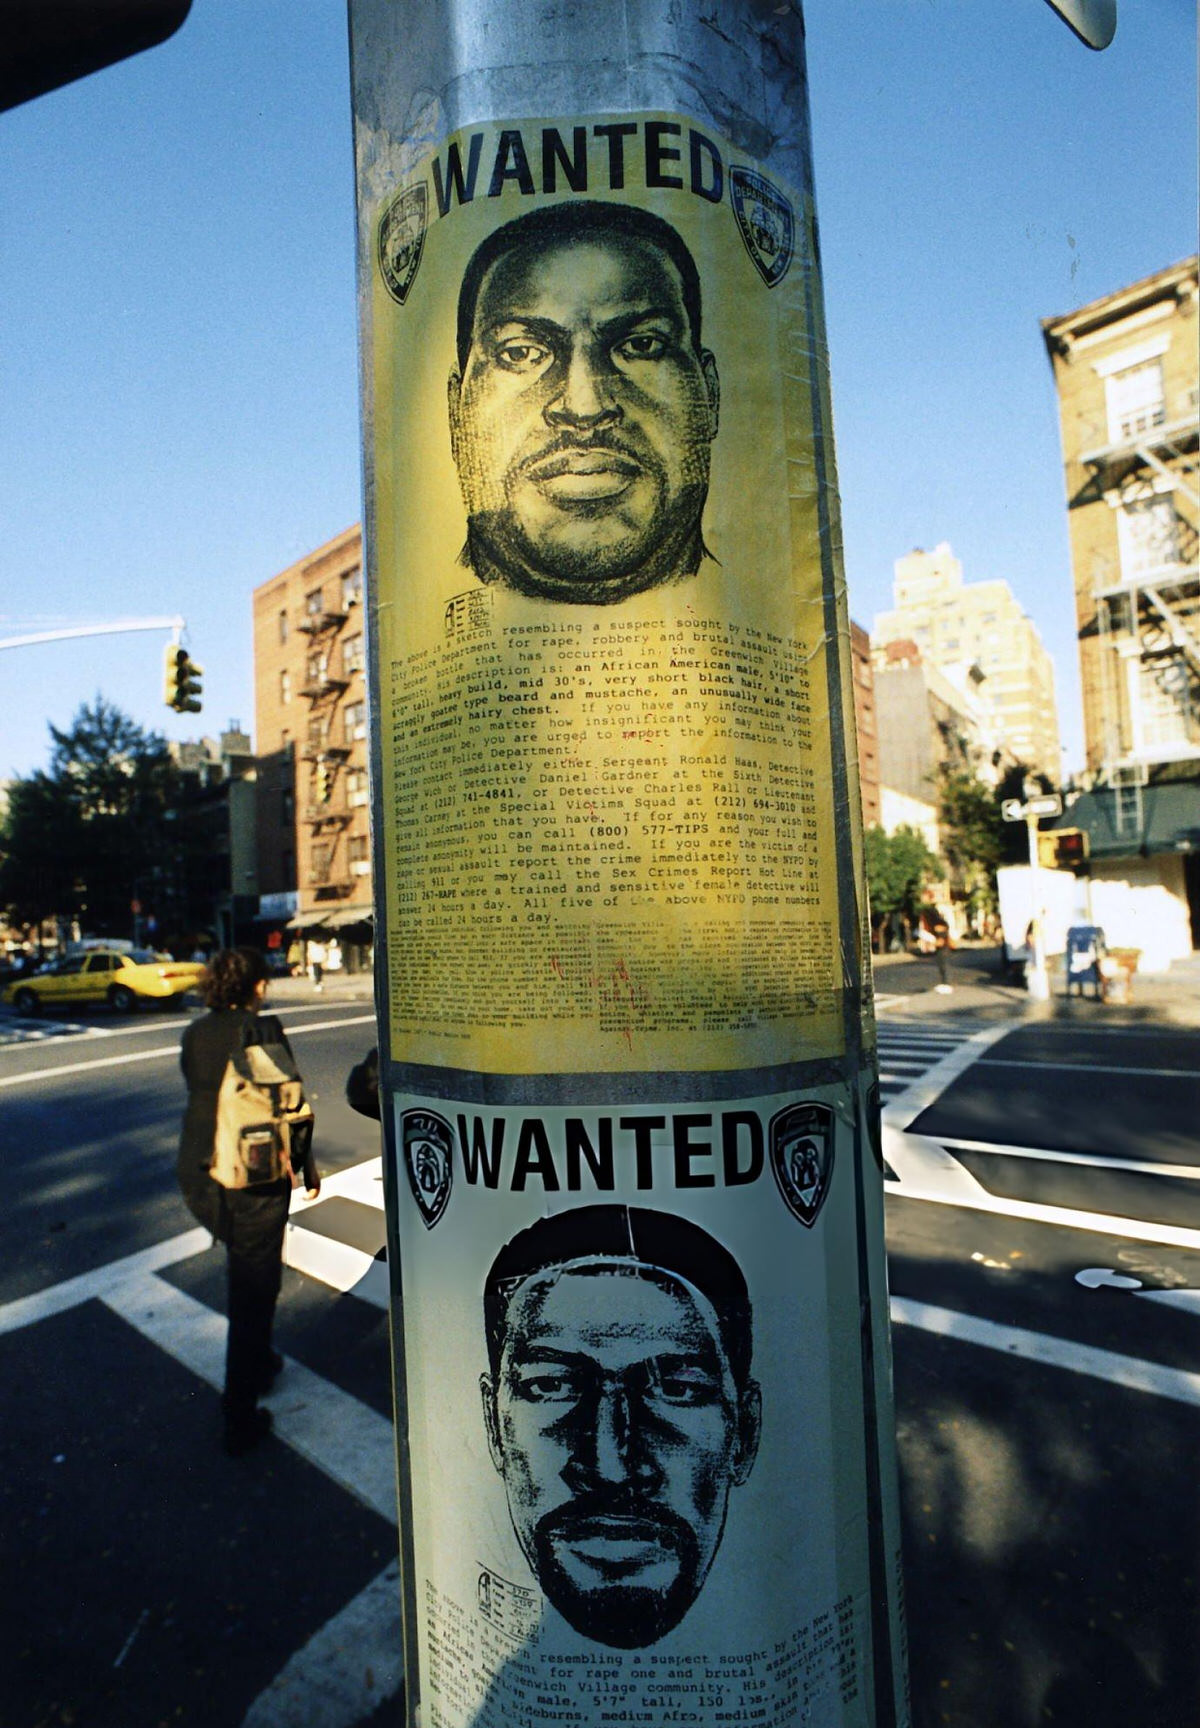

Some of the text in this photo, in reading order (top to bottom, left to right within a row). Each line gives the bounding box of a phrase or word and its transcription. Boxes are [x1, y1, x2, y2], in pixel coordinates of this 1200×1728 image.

[431, 121, 724, 219] WANTED
[508, 632, 734, 649] for robbery and brutal
[475, 646, 764, 667] that has occurred Greenwich
[455, 658, 731, 685] description is: an African American
[518, 672, 735, 690] mid very short black
[463, 686, 812, 714] type beard and an unusually wide face
[468, 701, 781, 721] hairy chest. If you have any information
[468, 714, 752, 735] no matter how insignificant you may
[483, 728, 778, 749] you are urged to the information
[451, 745, 579, 766] Police Department.
[543, 753, 727, 771] either Sergeant Ronald
[463, 768, 763, 790] Detective Daniel Gardner at the Sixth
[531, 782, 704, 799] or Detective Charles
[471, 795, 748, 817] the Special Victims Squad at (212)
[492, 810, 756, 829] that you for any reason
[477, 824, 740, 845] you can call (800) 577-TIPS and
[516, 838, 732, 853] be maintained. If you are
[458, 852, 757, 871] assault report the crime immediately to
[530, 866, 751, 881] call the Sex Crimes Report
[494, 879, 740, 896] a trained and sensitive female
[523, 896, 548, 908] All
[560, 896, 594, 908] five
[603, 897, 619, 908] of
[665, 894, 708, 905] above
[717, 893, 746, 904] NYPD
[510, 912, 559, 924] a day.
[457, 1110, 764, 1191] WANTED
[540, 1594, 853, 1668] resembling a suspect sought by the New York
[550, 1667, 574, 1678] for
[586, 1669, 620, 1681] rape
[630, 1670, 656, 1679] one
[668, 1669, 693, 1679] and
[705, 1666, 754, 1678] brutal
[766, 1641, 806, 1671] assault
[813, 1623, 833, 1642] that
[578, 1682, 637, 1694] Village
[648, 1682, 731, 1695] community.
[743, 1679, 766, 1690] His
[538, 1694, 577, 1707] male,
[593, 1695, 626, 1707] 5'7"
[642, 1696, 682, 1707] tall,
[698, 1695, 723, 1707] 150
[601, 1709, 653, 1721] medium
[663, 1710, 704, 1722] Afro,
[714, 1708, 767, 1720] medium
[774, 1691, 798, 1711] skin
